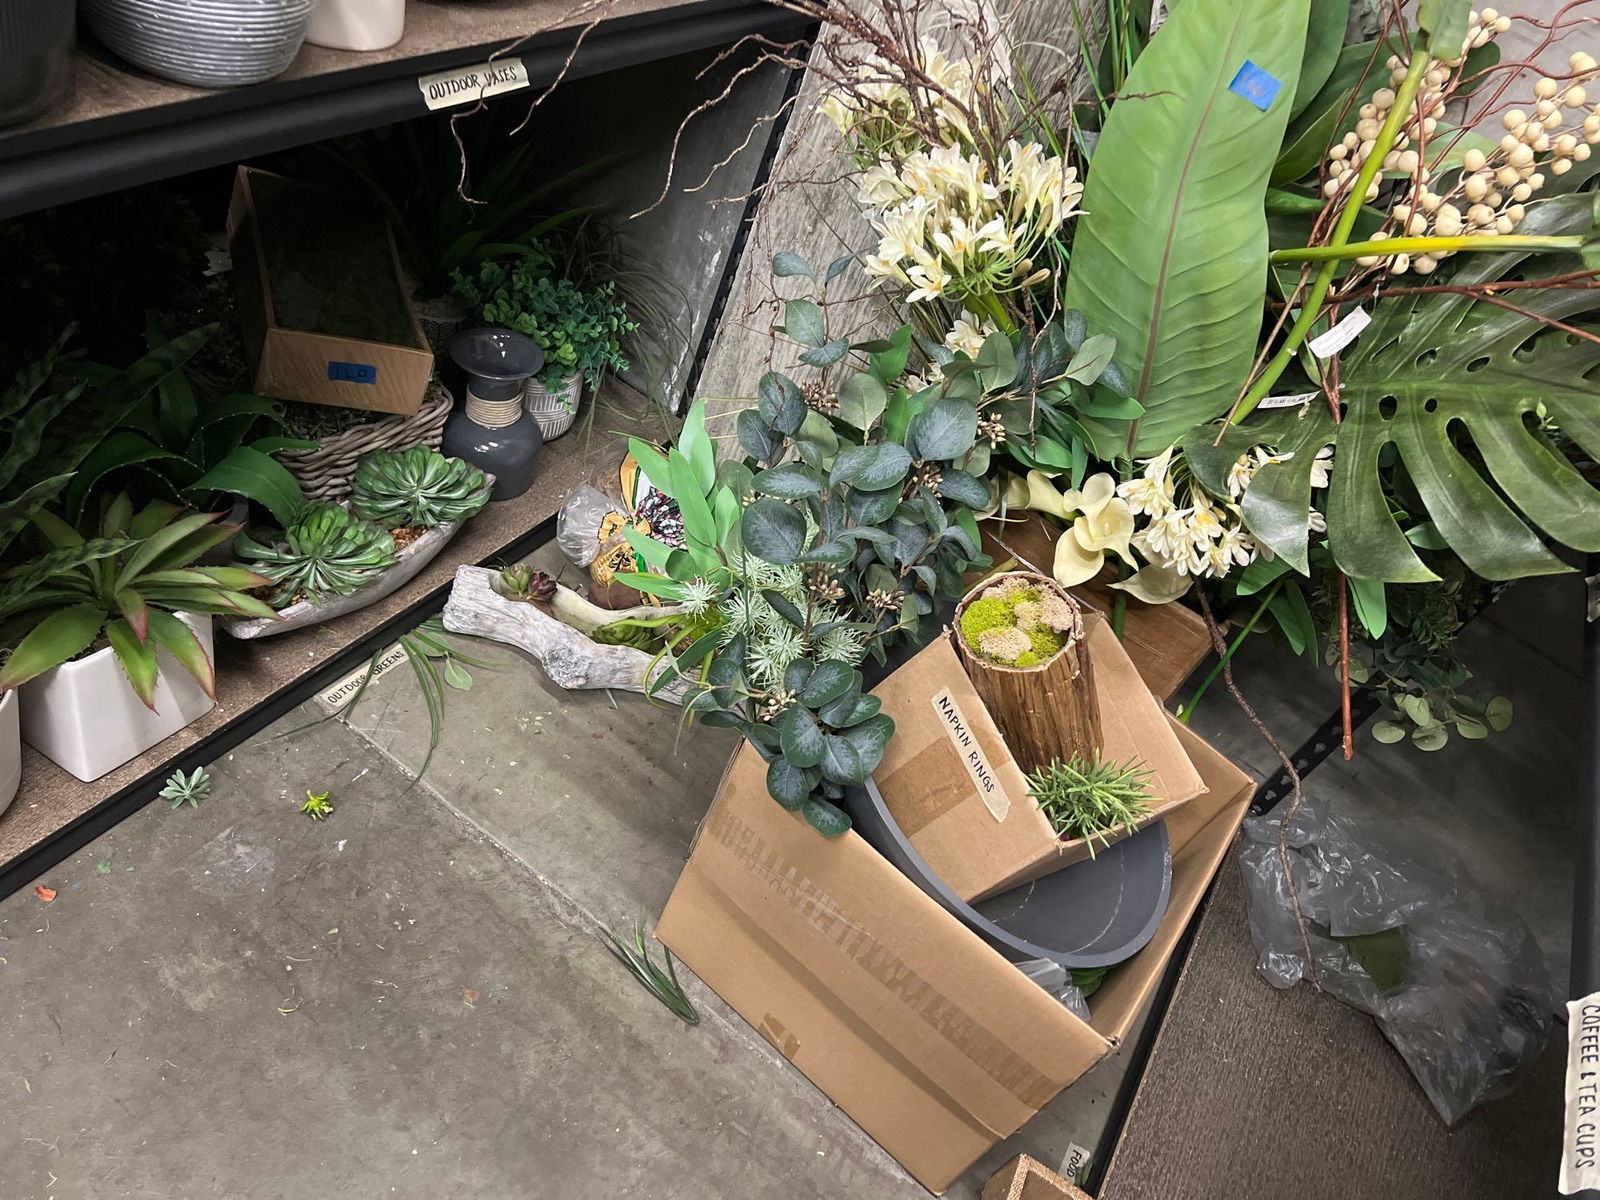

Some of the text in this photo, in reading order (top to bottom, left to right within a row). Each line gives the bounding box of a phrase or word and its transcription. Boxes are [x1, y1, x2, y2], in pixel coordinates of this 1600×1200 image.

[429, 66, 517, 100] OUTDOOR VASES
[373, 651, 404, 675] GREENS
[939, 696, 995, 793] NAPKIN RINGS
[1580, 1005, 1600, 1064] COFFEE
[1578, 1083, 1597, 1116] TEA
[1575, 1123, 1596, 1169] CUPS
[1066, 1149, 1082, 1178] FOOD
